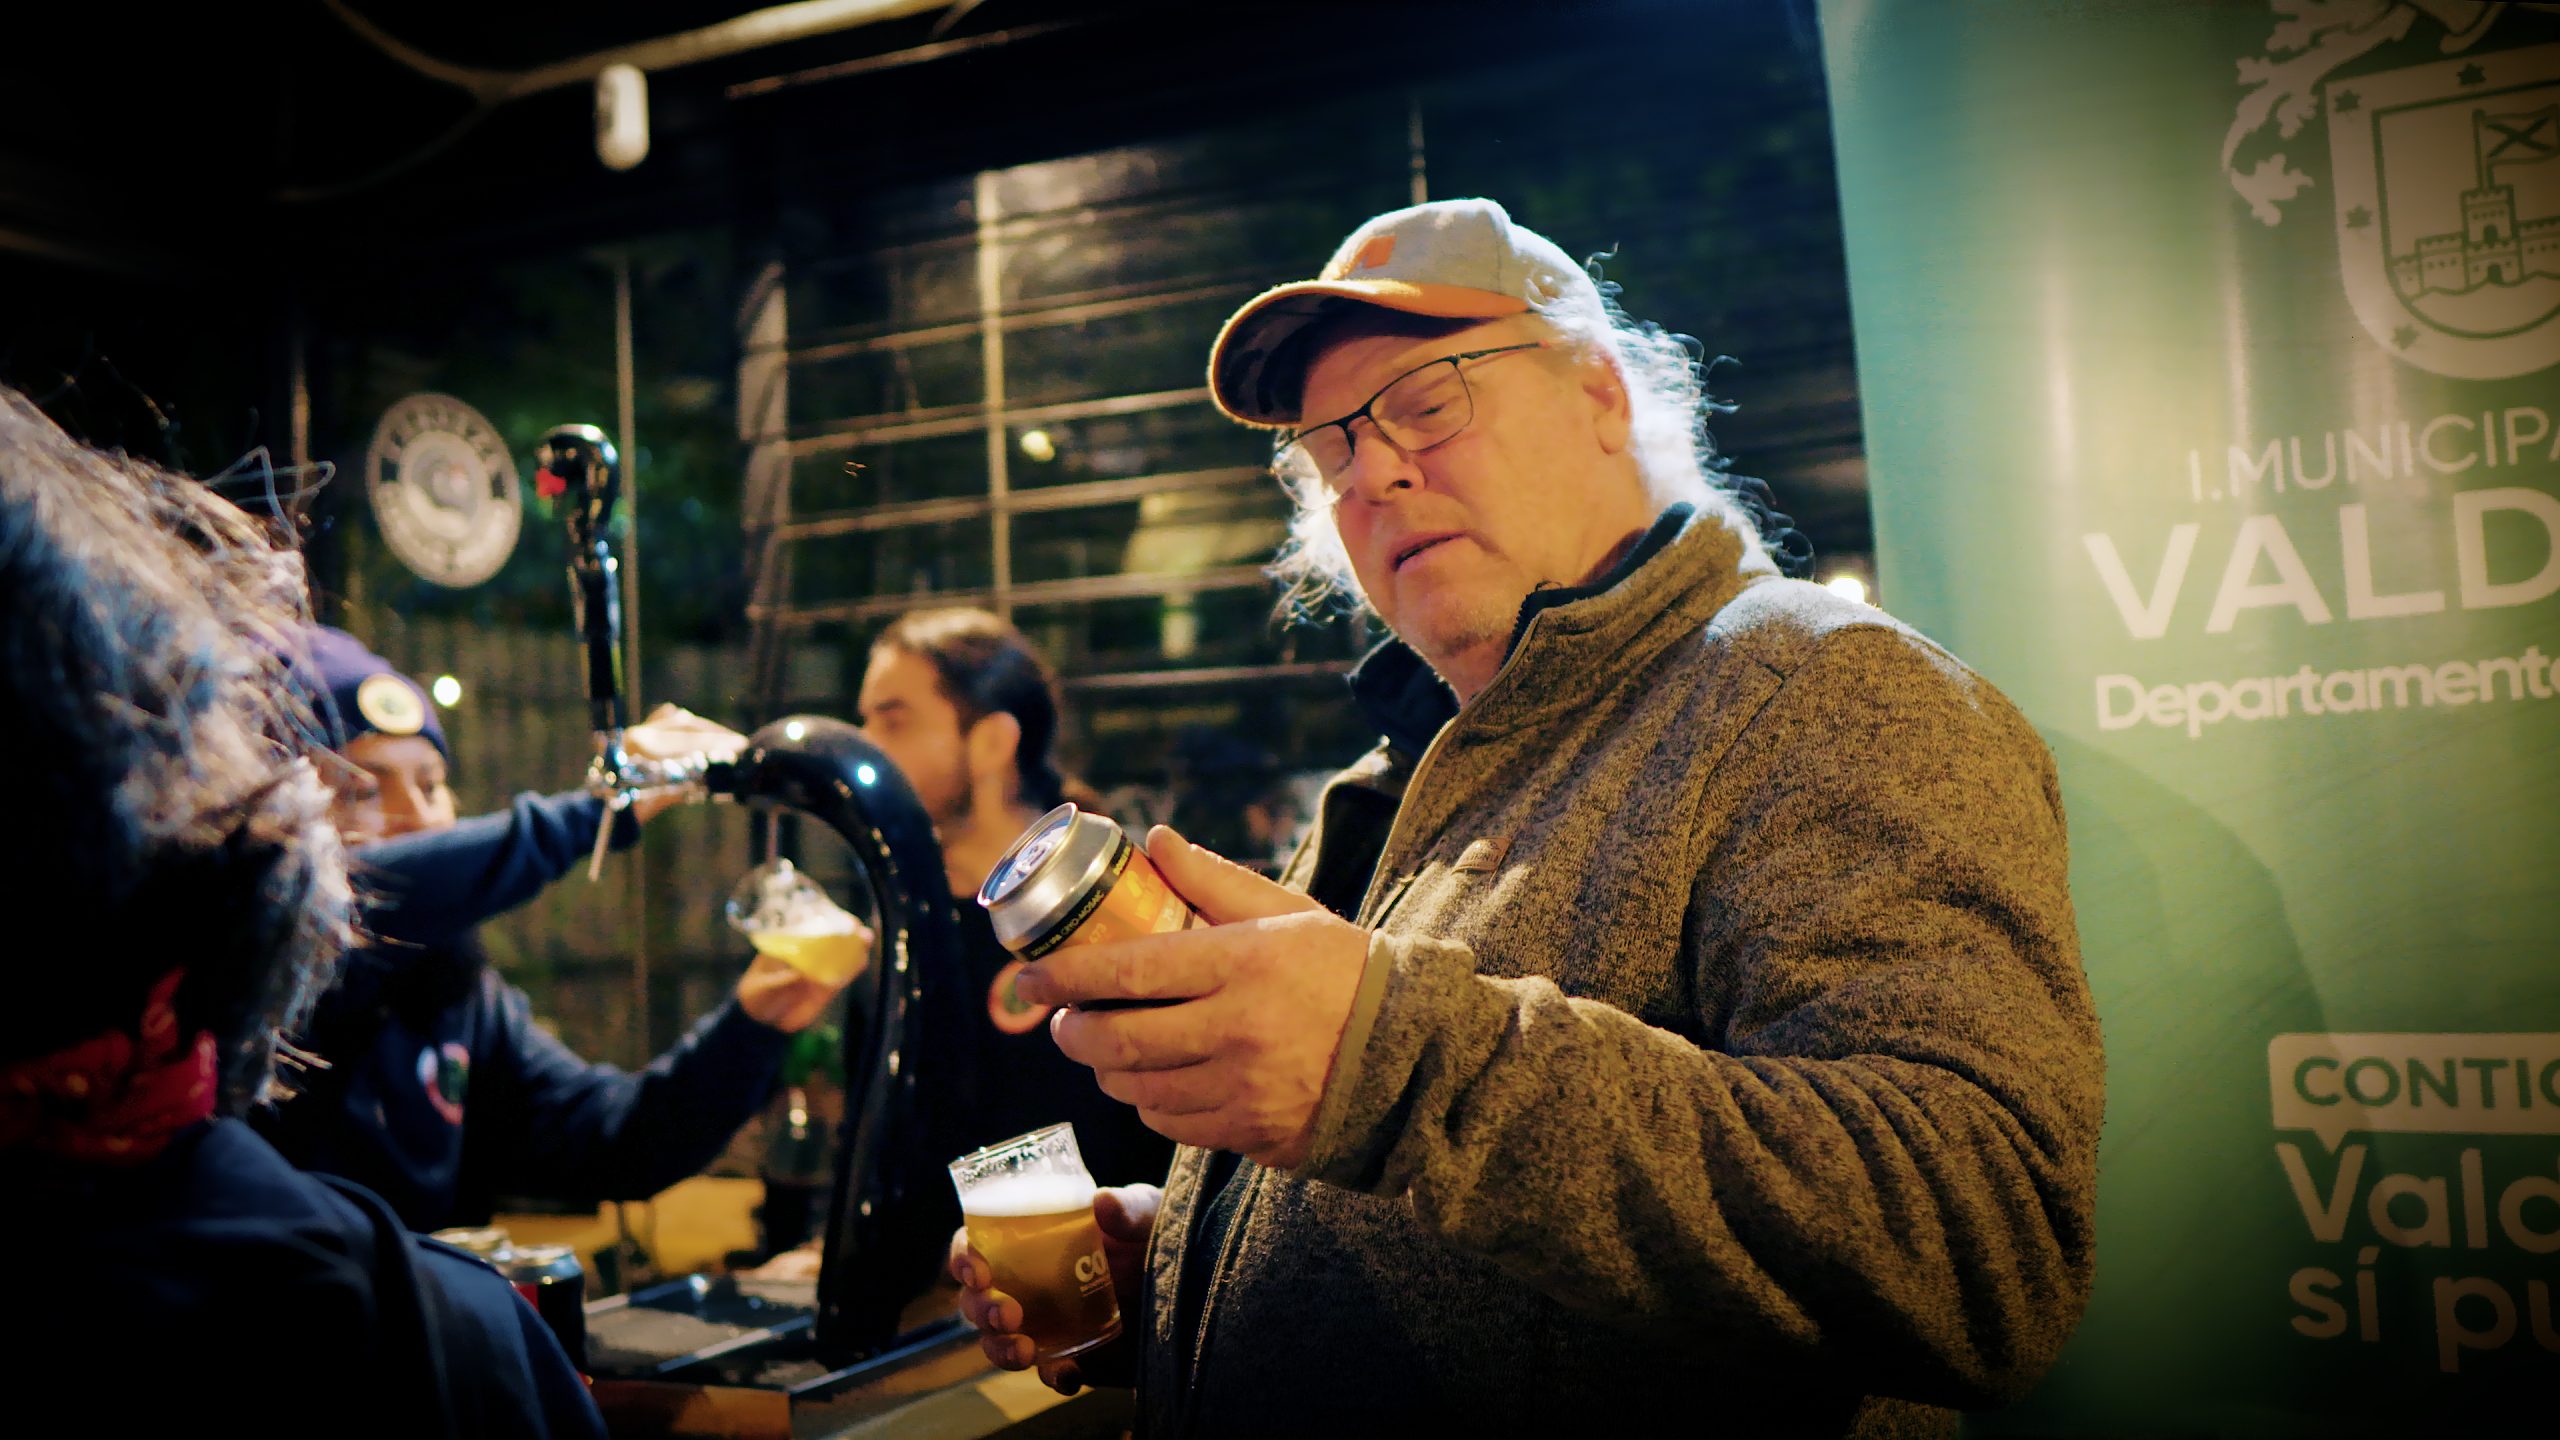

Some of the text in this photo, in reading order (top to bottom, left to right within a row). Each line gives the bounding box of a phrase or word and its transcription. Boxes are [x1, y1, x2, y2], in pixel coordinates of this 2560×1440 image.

[2189, 406, 2560, 503] I.MUNICIP
[2082, 486, 2560, 640] VALD
[2096, 646, 2560, 738] Departament
[2288, 1246, 2381, 1342] sí
